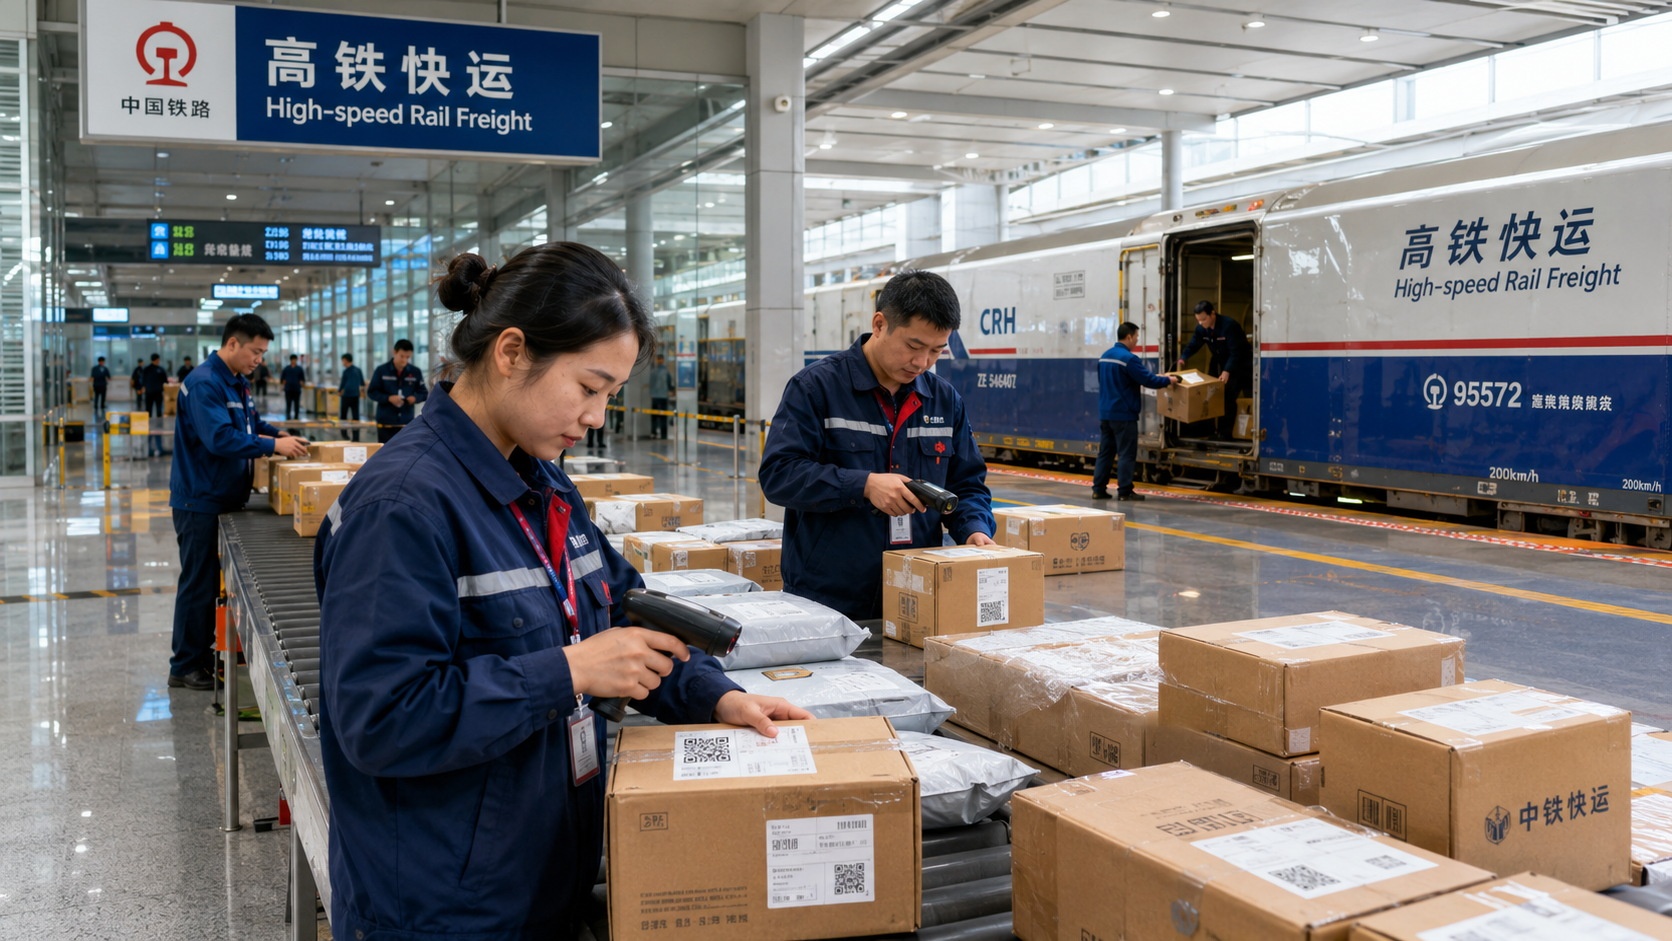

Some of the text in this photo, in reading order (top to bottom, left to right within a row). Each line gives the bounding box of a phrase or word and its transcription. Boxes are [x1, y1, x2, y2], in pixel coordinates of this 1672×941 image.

[264, 36, 515, 100] 高铁快运
[121, 95, 211, 119] 中国铁路
[266, 96, 533, 135] High-speed Rail Freight
[1399, 207, 1594, 270] 高铁快运
[1394, 262, 1622, 302] High-speed Rail Freight
[980, 306, 1016, 336] CRH
[1453, 381, 1522, 408] 95572
[1489, 466, 1539, 483] 200km/h
[1622, 478, 1662, 493] 200km/h
[1518, 784, 1611, 833] 中铁快运
